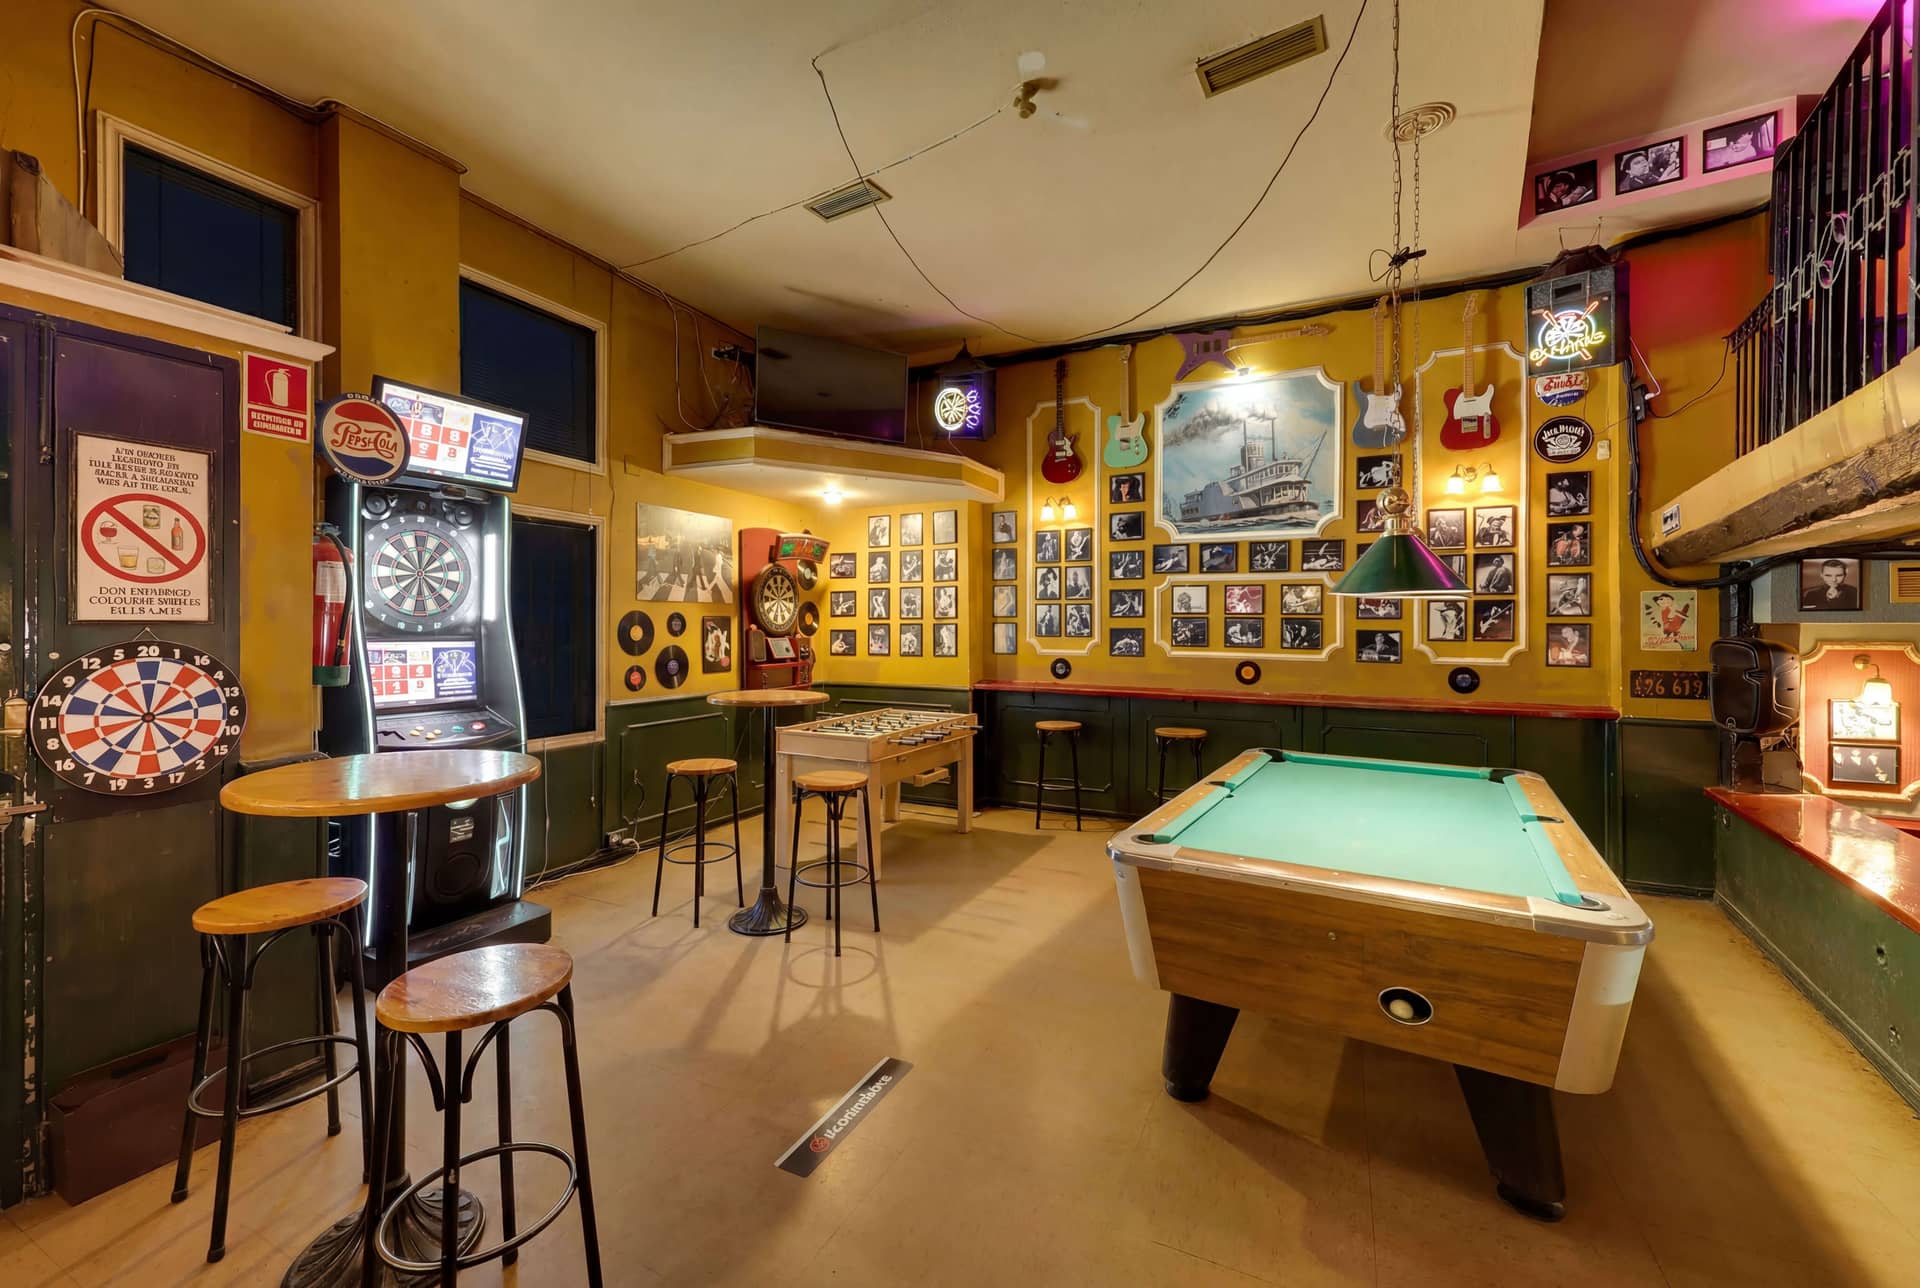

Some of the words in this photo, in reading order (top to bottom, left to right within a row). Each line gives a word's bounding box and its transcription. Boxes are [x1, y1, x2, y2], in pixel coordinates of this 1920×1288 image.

[113, 649, 124, 660] 5
[137, 646, 160, 656] 20
[172, 648, 180, 659] 1
[80, 658, 101, 670] 12
[194, 656, 210, 666] 16
[213, 670, 224, 680] 4
[62, 676, 76, 688] 9
[224, 687, 240, 697] 13
[41, 695, 62, 708] 14
[229, 706, 240, 716] 6
[40, 717, 57, 730] 11
[225, 724, 240, 736] 10
[46, 738, 60, 750] 8
[214, 745, 228, 756] 15
[54, 758, 76, 772] 16
[195, 760, 206, 770] 2
[83, 772, 96, 785] 7
[144, 778, 154, 788] 3
[168, 772, 186, 784] 17
[109, 778, 128, 791] 19
